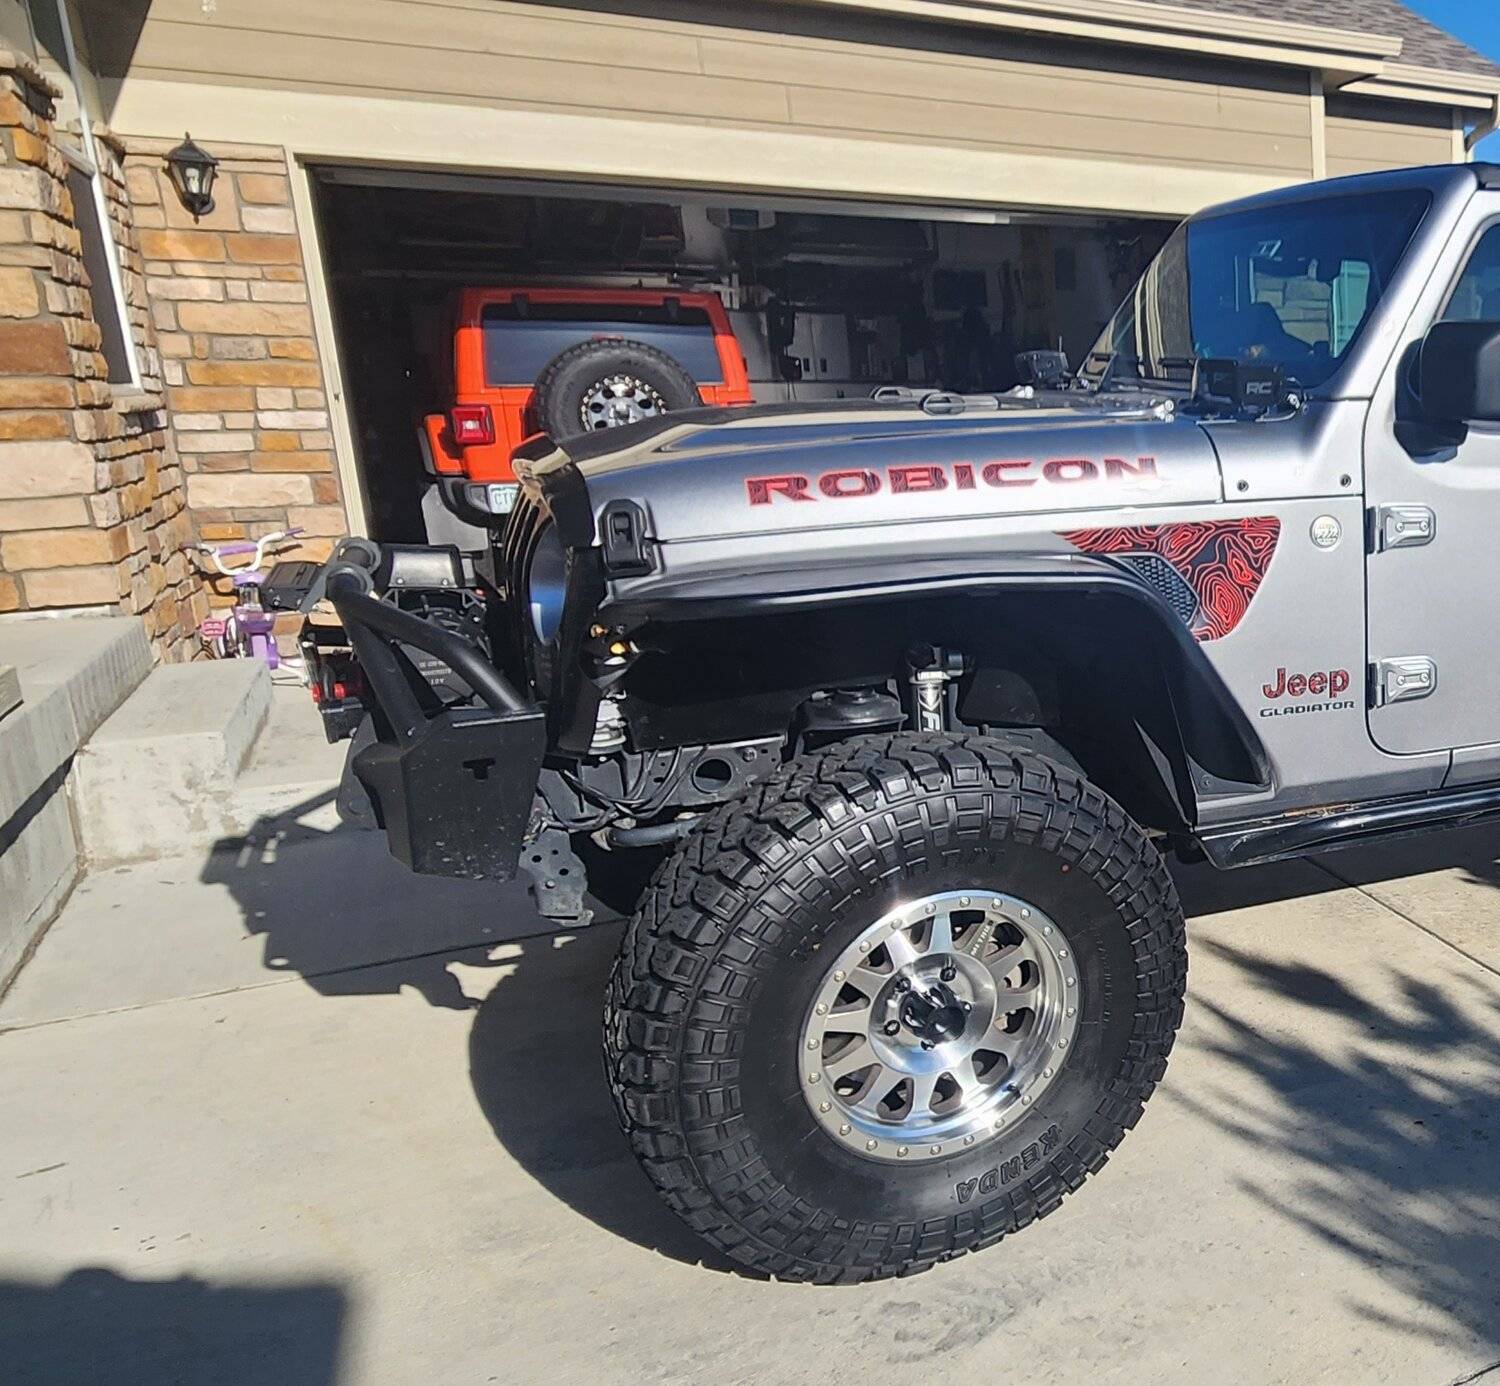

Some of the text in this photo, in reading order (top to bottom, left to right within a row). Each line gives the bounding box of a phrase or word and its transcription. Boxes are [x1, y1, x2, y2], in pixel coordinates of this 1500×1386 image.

[1246, 381, 1272, 395] RC
[1262, 667, 1350, 699] Jeep
[1260, 700, 1355, 718] GLADIATOR
[955, 1124, 1062, 1204] KENDA
